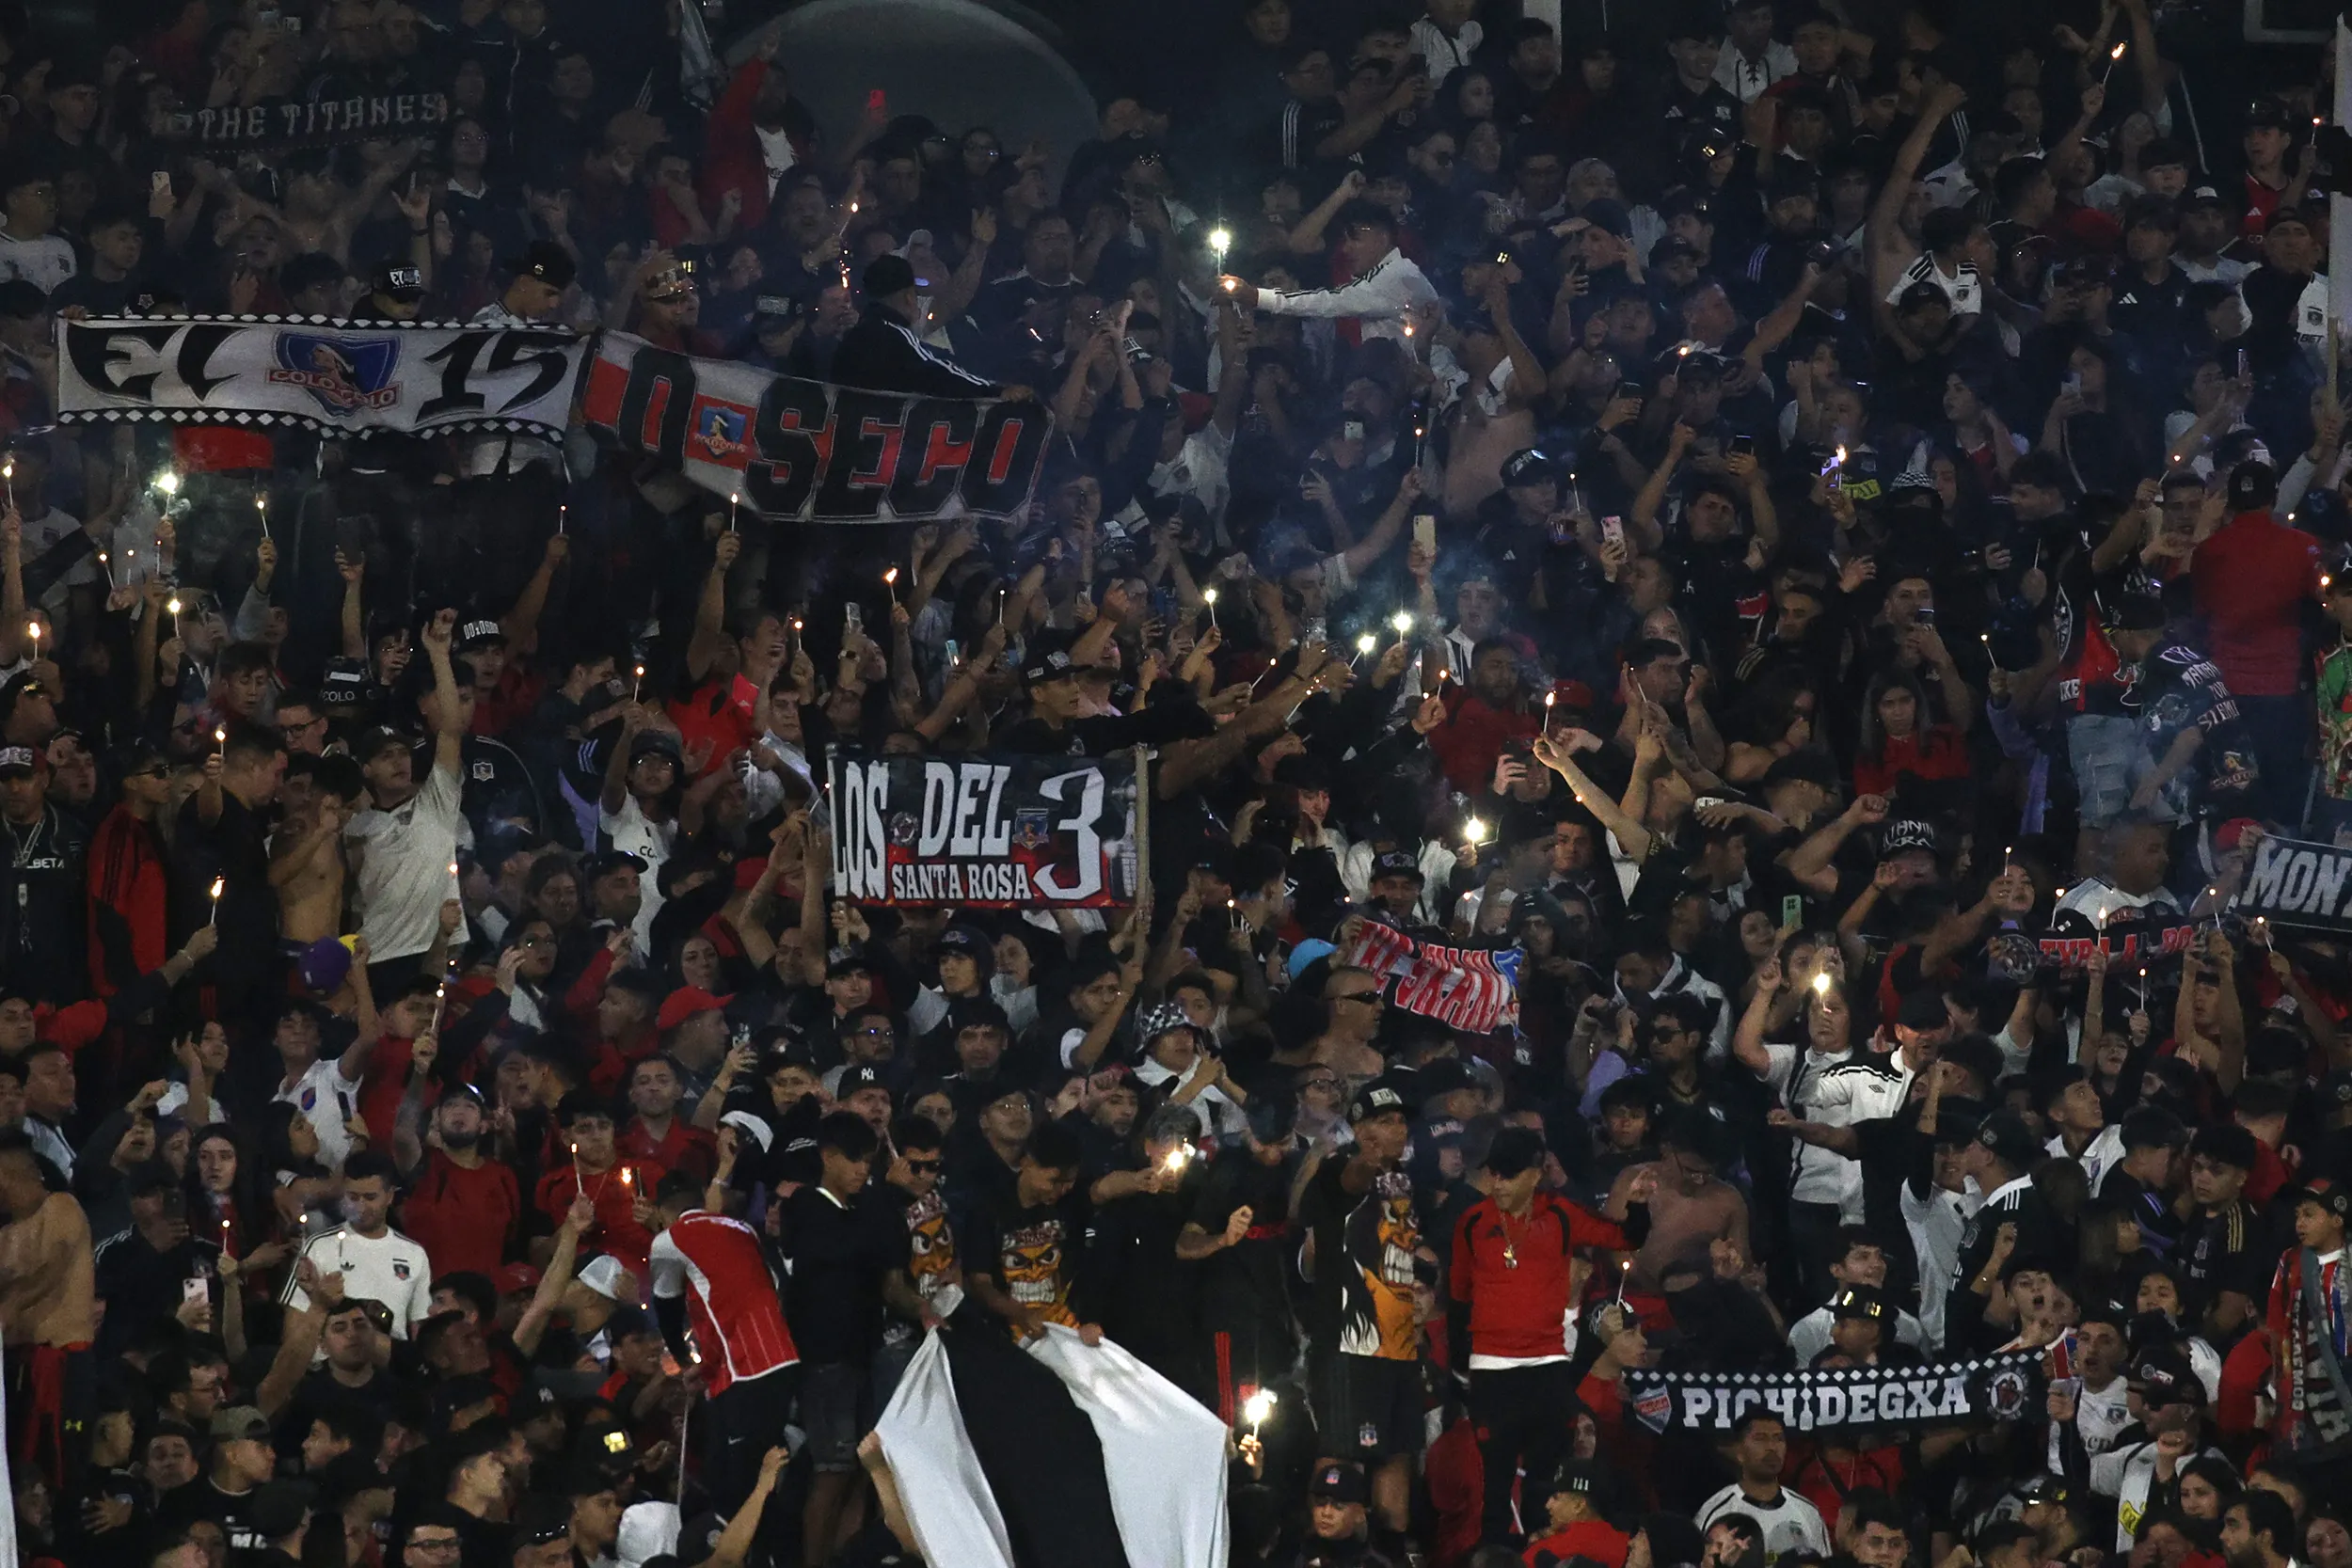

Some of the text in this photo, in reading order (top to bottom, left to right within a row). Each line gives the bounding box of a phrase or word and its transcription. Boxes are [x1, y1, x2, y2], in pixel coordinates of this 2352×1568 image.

[197, 93, 449, 140] THE TITANES
[67, 324, 589, 424] EL 15
[746, 376, 1055, 517] SECO
[826, 753, 1105, 900] LOS DEL 3
[891, 863, 1033, 900] SANTA ROSA
[2240, 836, 2352, 918] MON
